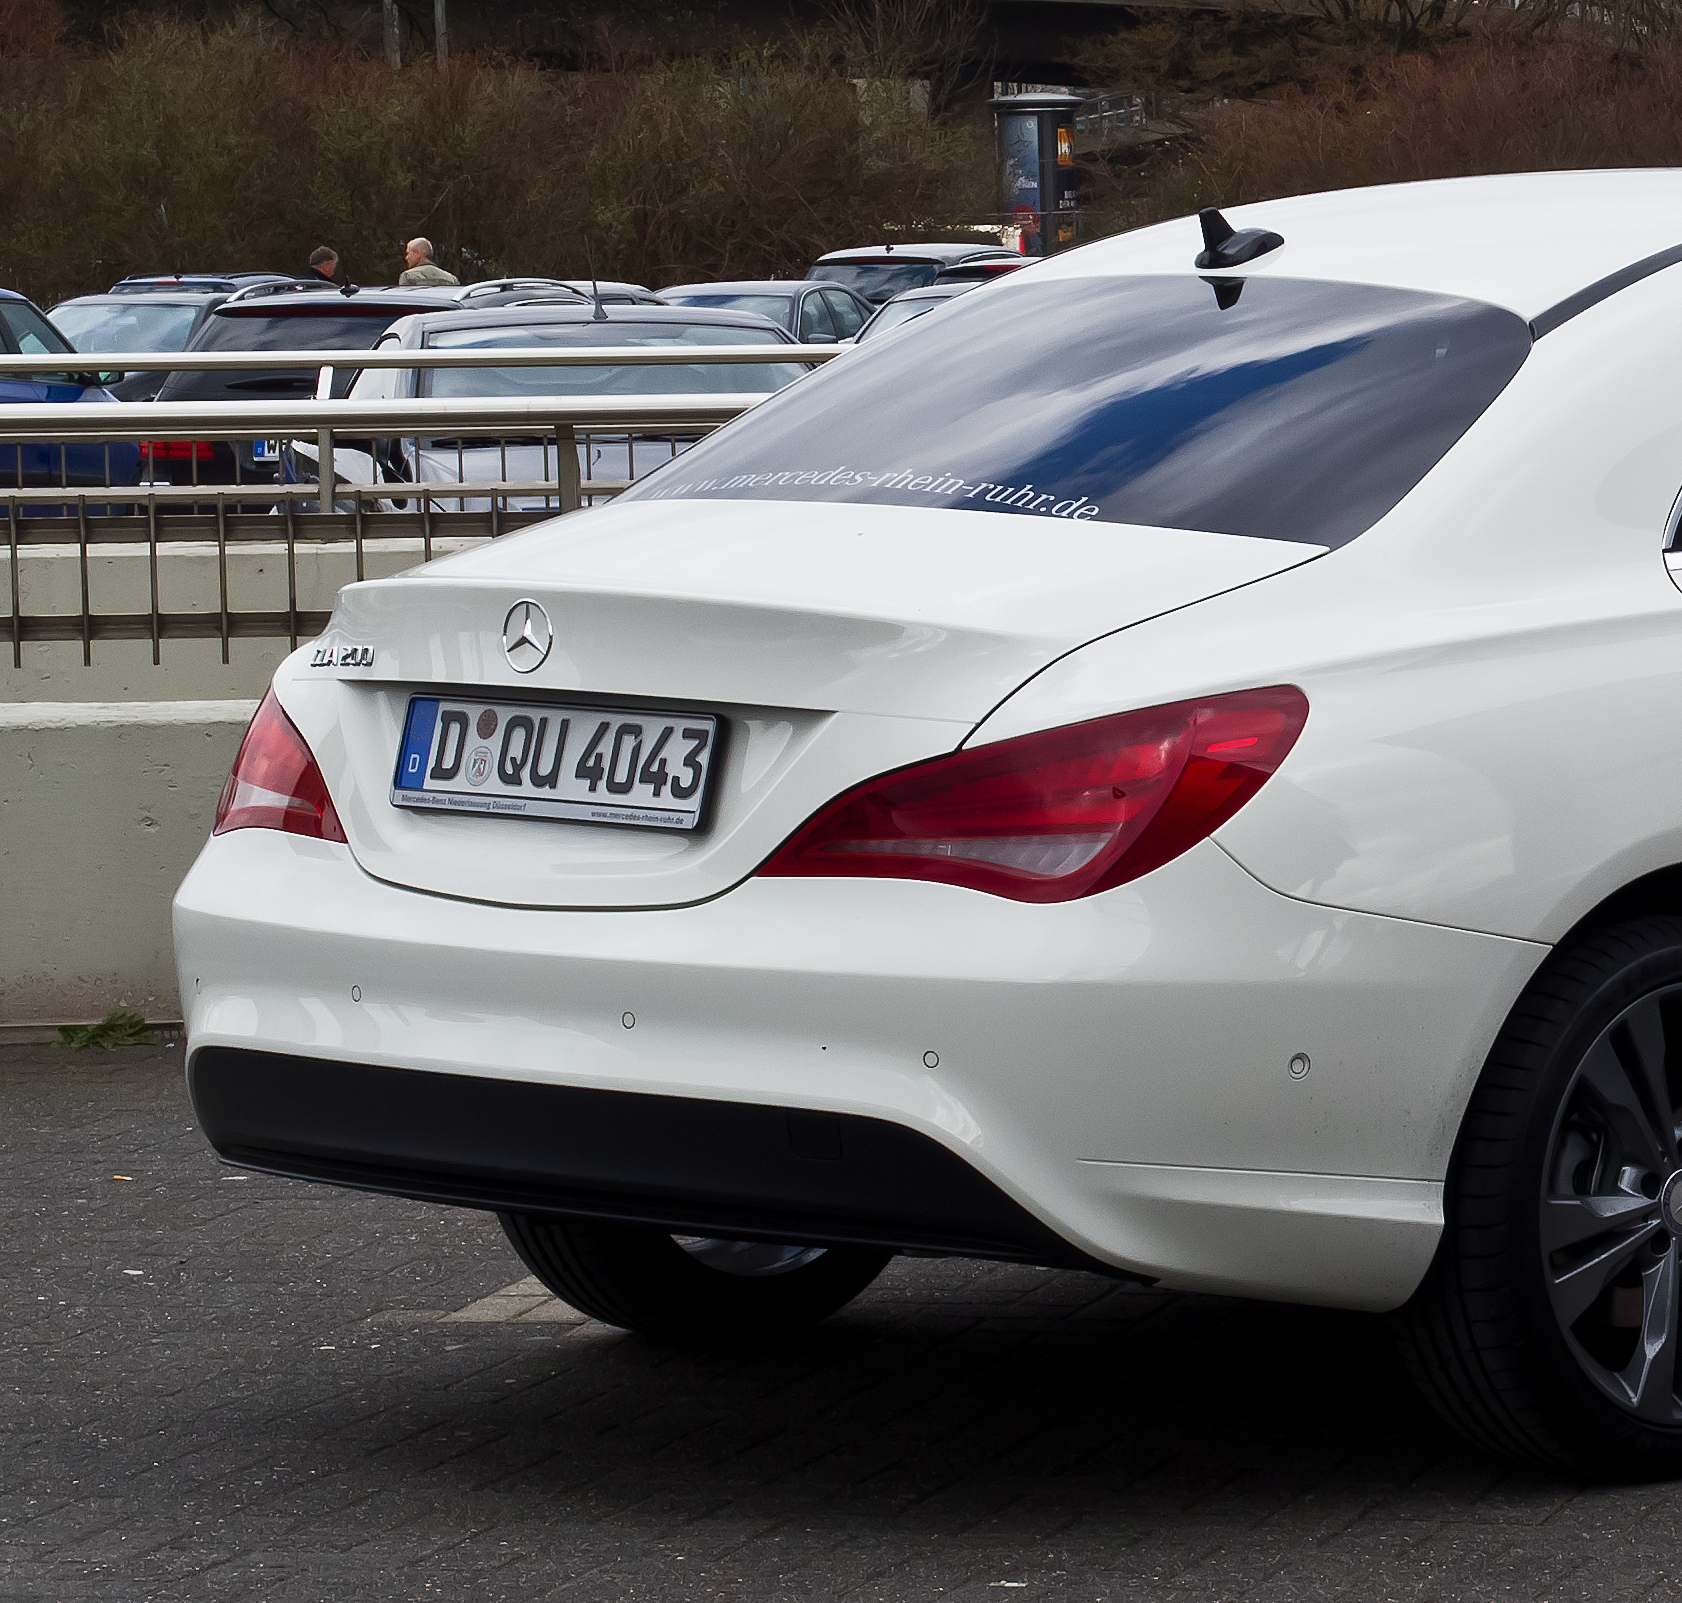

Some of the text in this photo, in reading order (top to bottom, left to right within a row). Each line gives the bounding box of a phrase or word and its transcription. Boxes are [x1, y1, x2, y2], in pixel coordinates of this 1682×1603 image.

[648, 466, 1100, 520] www.mercedes-rhein-ruhr.de
[340, 645, 375, 667] 200
[407, 753, 420, 773] D
[429, 709, 710, 800] D QU 4043
[400, 793, 528, 812] Mercedes-Benz Niederlassung Düsseldorf
